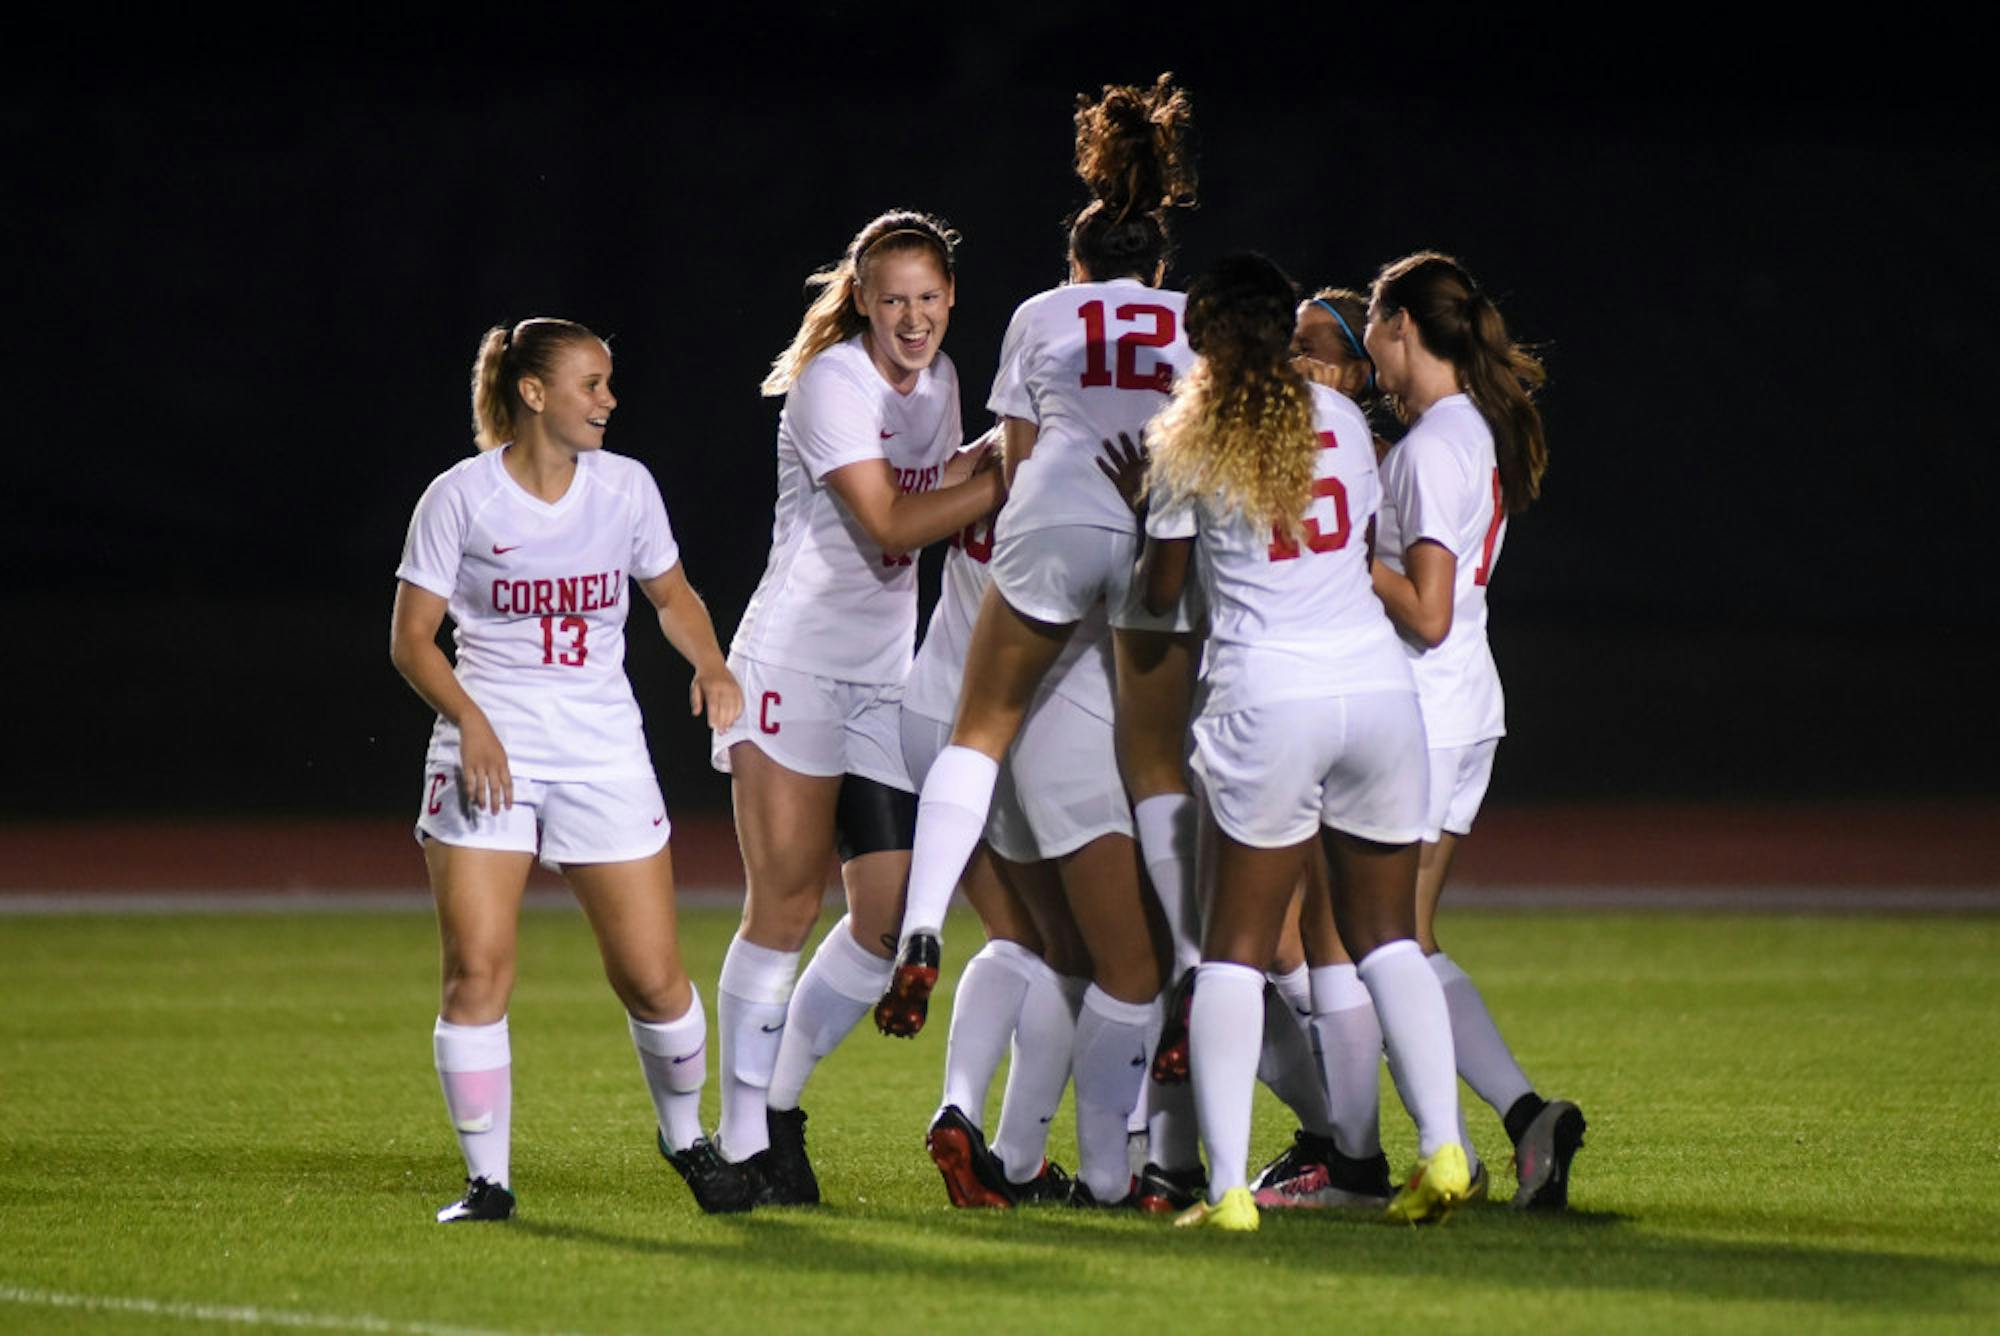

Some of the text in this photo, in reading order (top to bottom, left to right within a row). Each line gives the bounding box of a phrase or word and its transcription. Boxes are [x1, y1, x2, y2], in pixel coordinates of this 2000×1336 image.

[1077, 300, 1176, 394] 12
[540, 614, 588, 668] 13
[760, 690, 782, 736] C
[428, 772, 447, 816] C
